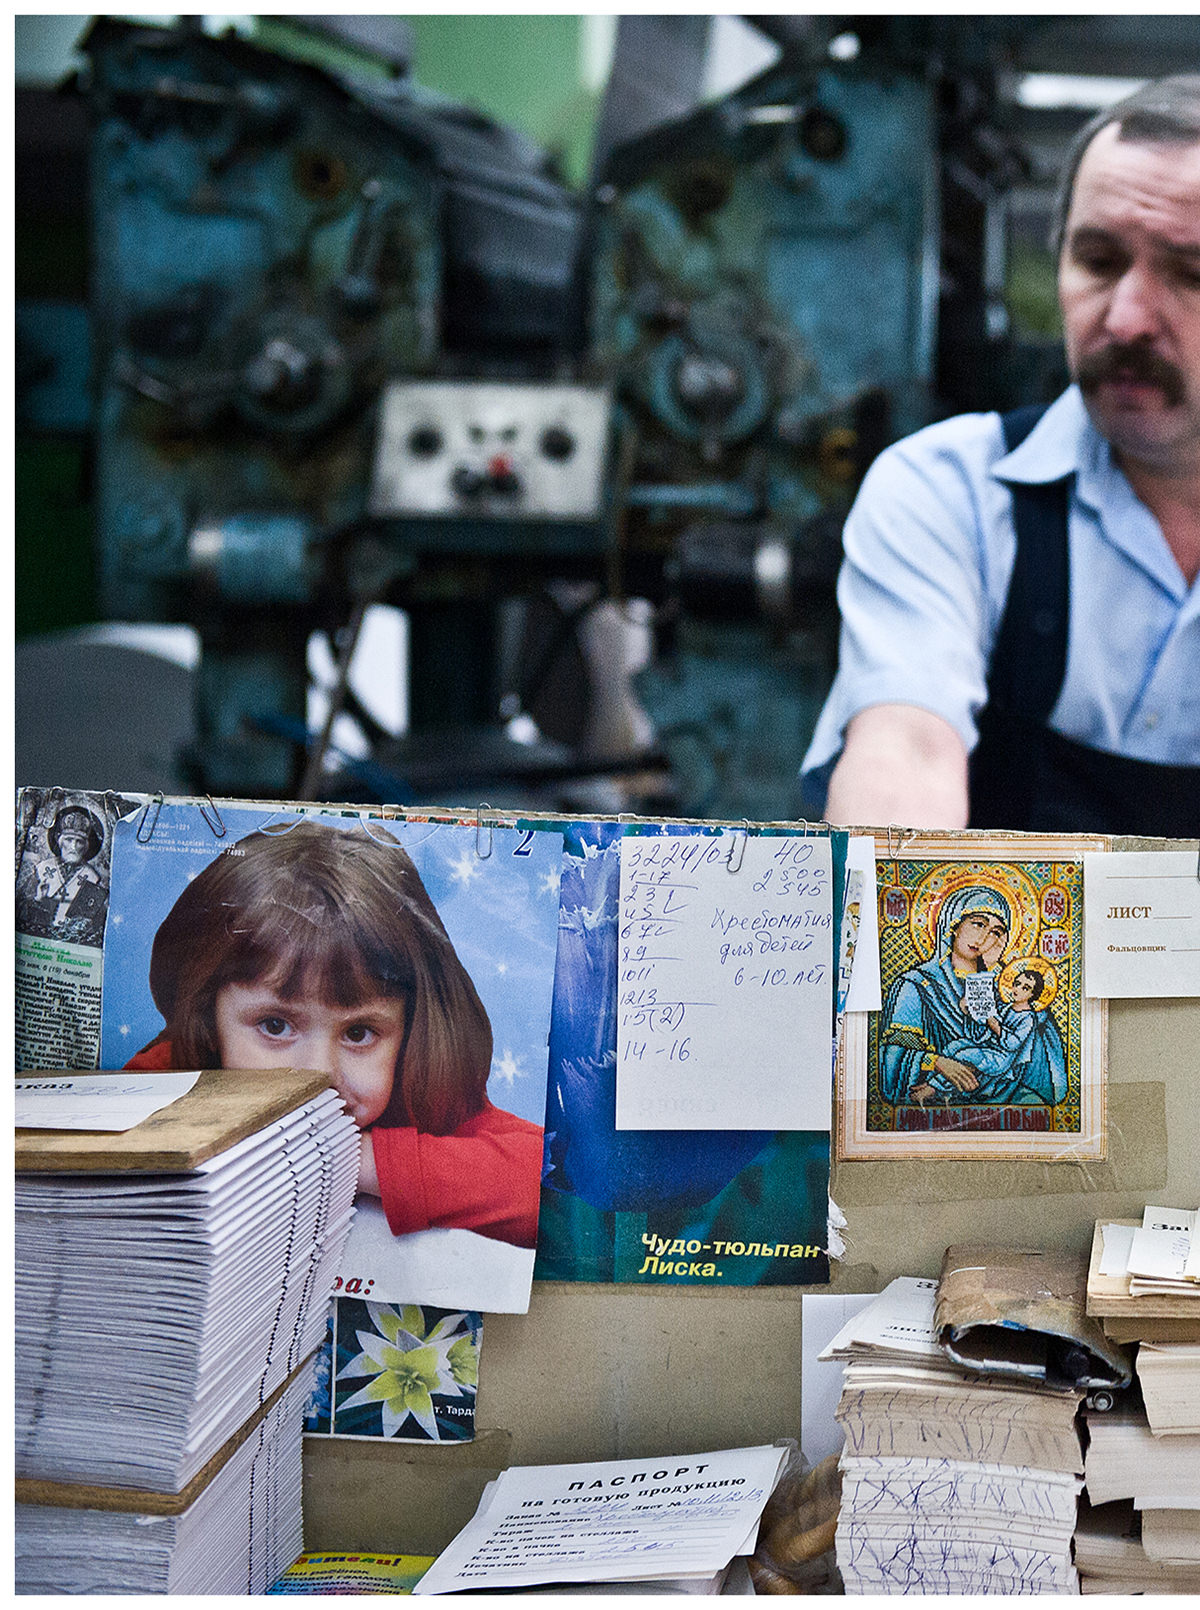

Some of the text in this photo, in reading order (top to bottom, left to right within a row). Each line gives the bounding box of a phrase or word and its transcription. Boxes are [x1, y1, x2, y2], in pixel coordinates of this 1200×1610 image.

[512, 829, 536, 857] 2
[774, 839, 813, 865] 40
[1107, 906, 1152, 919] ЛИСТ
[1107, 945, 1167, 953] Фальцовщик
[641, 1233, 820, 1258] Чудо-тюльпан
[638, 1256, 724, 1277] Лиска.
[568, 1464, 709, 1491] ПАСПОРТ
[521, 1478, 746, 1508] на готовую продукцию
